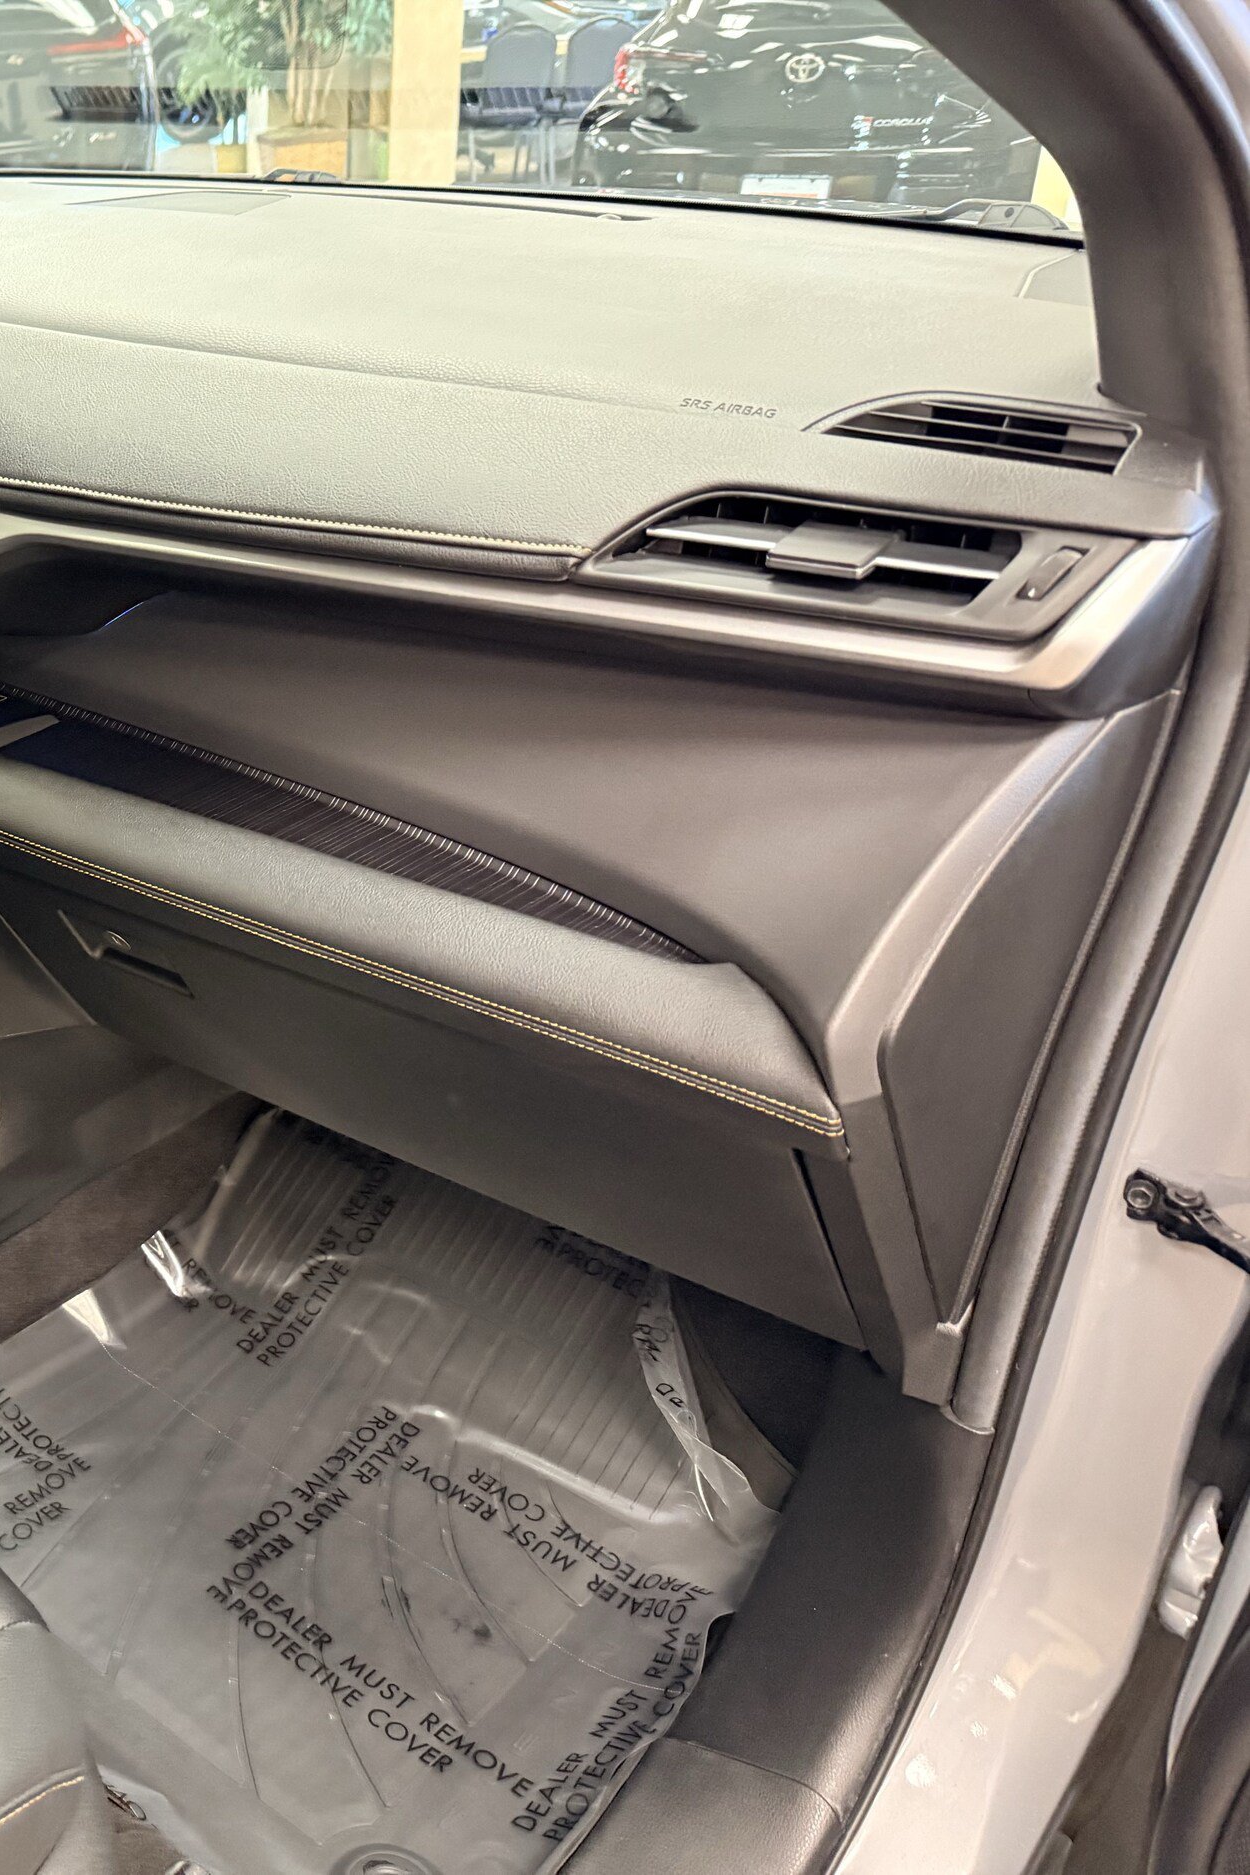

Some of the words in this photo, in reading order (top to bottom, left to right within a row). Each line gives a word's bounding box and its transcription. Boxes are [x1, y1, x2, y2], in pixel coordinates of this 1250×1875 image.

[680, 398, 713, 410] SRS
[713, 402, 778, 419] AIRBAG
[236, 1291, 299, 1354] DEALER
[302, 1226, 344, 1283] MUST
[342, 1156, 396, 1220] REMOV
[256, 1261, 350, 1367] PROTECTIVE
[346, 1195, 398, 1257] COVER
[3, 1456, 92, 1515] REMOVE
[290, 1406, 397, 1502] PROTECTIVE
[351, 1421, 421, 1485] DEALER
[295, 1487, 353, 1535] MUST
[400, 1455, 498, 1521] REMOVE
[468, 1467, 546, 1522] COVER
[225, 1501, 293, 1549] COVER
[504, 1523, 578, 1572] MUST
[551, 1523, 690, 1594] PROTECTIVE
[206, 1533, 295, 1603] REMOVE
[586, 1573, 670, 1618] DEALER
[227, 1598, 364, 1708] PROTECTIVE
[367, 1708, 454, 1773] COVER
[248, 1581, 333, 1650] DEALER
[340, 1654, 415, 1709] MUST
[419, 1712, 534, 1797] REMOVE
[511, 1752, 589, 1832] DEALER
[588, 1689, 648, 1738] MUST
[644, 1584, 714, 1679] REMOVE
[543, 1720, 657, 1842] PROTECTIVE
[653, 1632, 702, 1717] COVER
